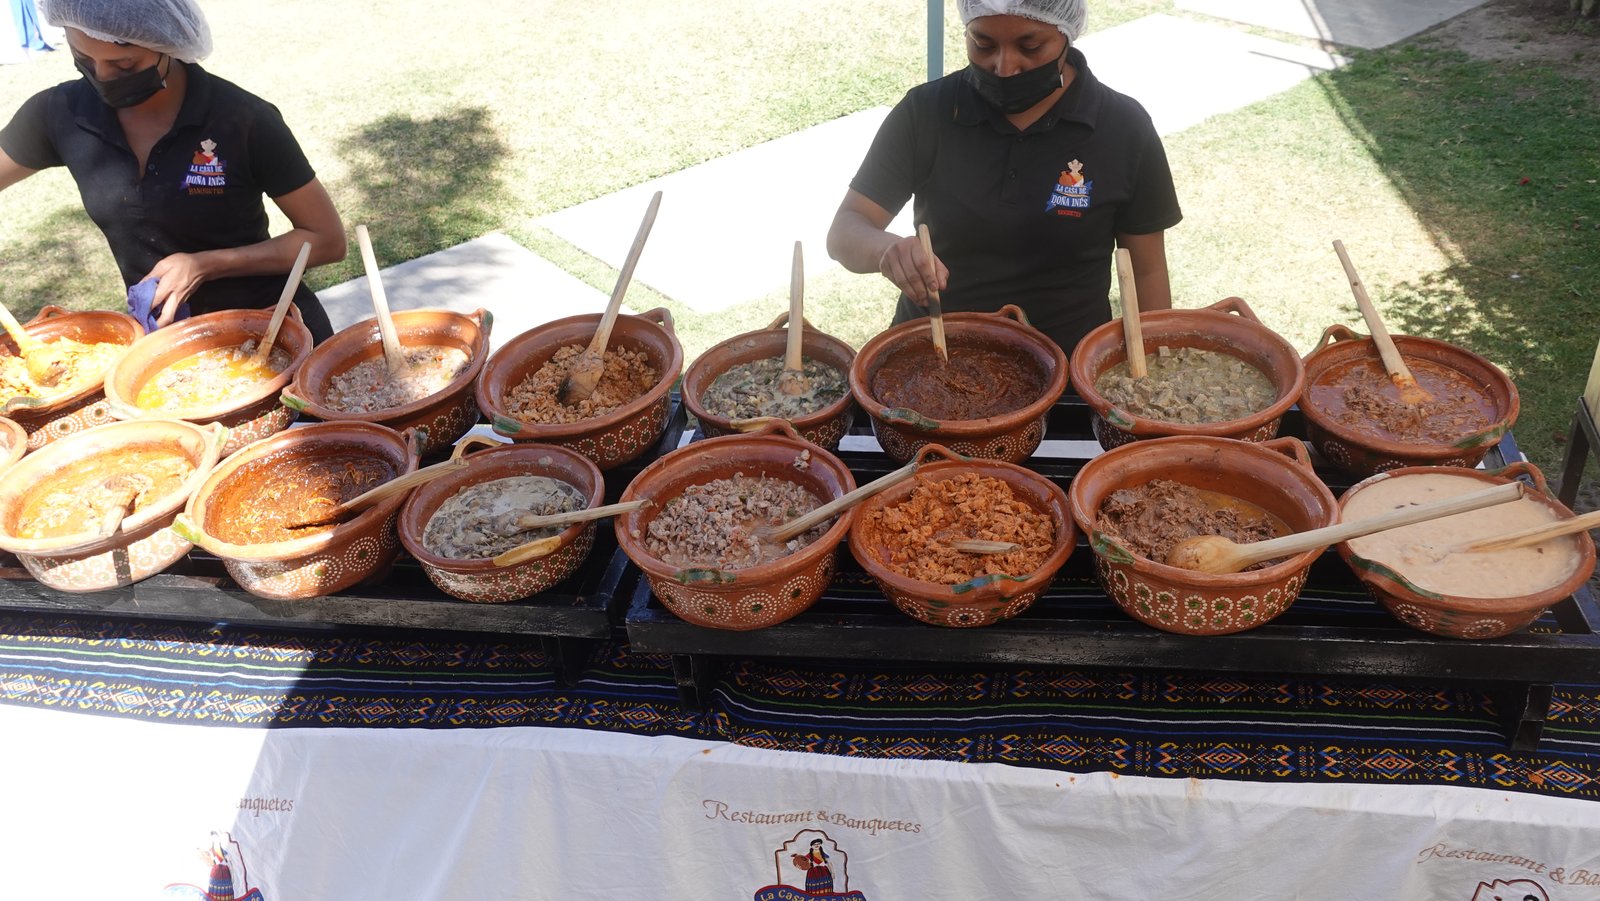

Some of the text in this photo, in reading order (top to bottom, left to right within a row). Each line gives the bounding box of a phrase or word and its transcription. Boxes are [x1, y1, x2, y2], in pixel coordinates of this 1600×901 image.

[199, 165, 214, 173] CASA
[186, 174, 206, 186] DOÑA
[1056, 184, 1087, 195] LA CASA DE
[1051, 194, 1089, 208] DOÑA INÉS
[702, 799, 922, 837] Restaurant & Banquetes
[1417, 842, 1600, 886] Restaurant & Ba
[760, 892, 775, 901] La
